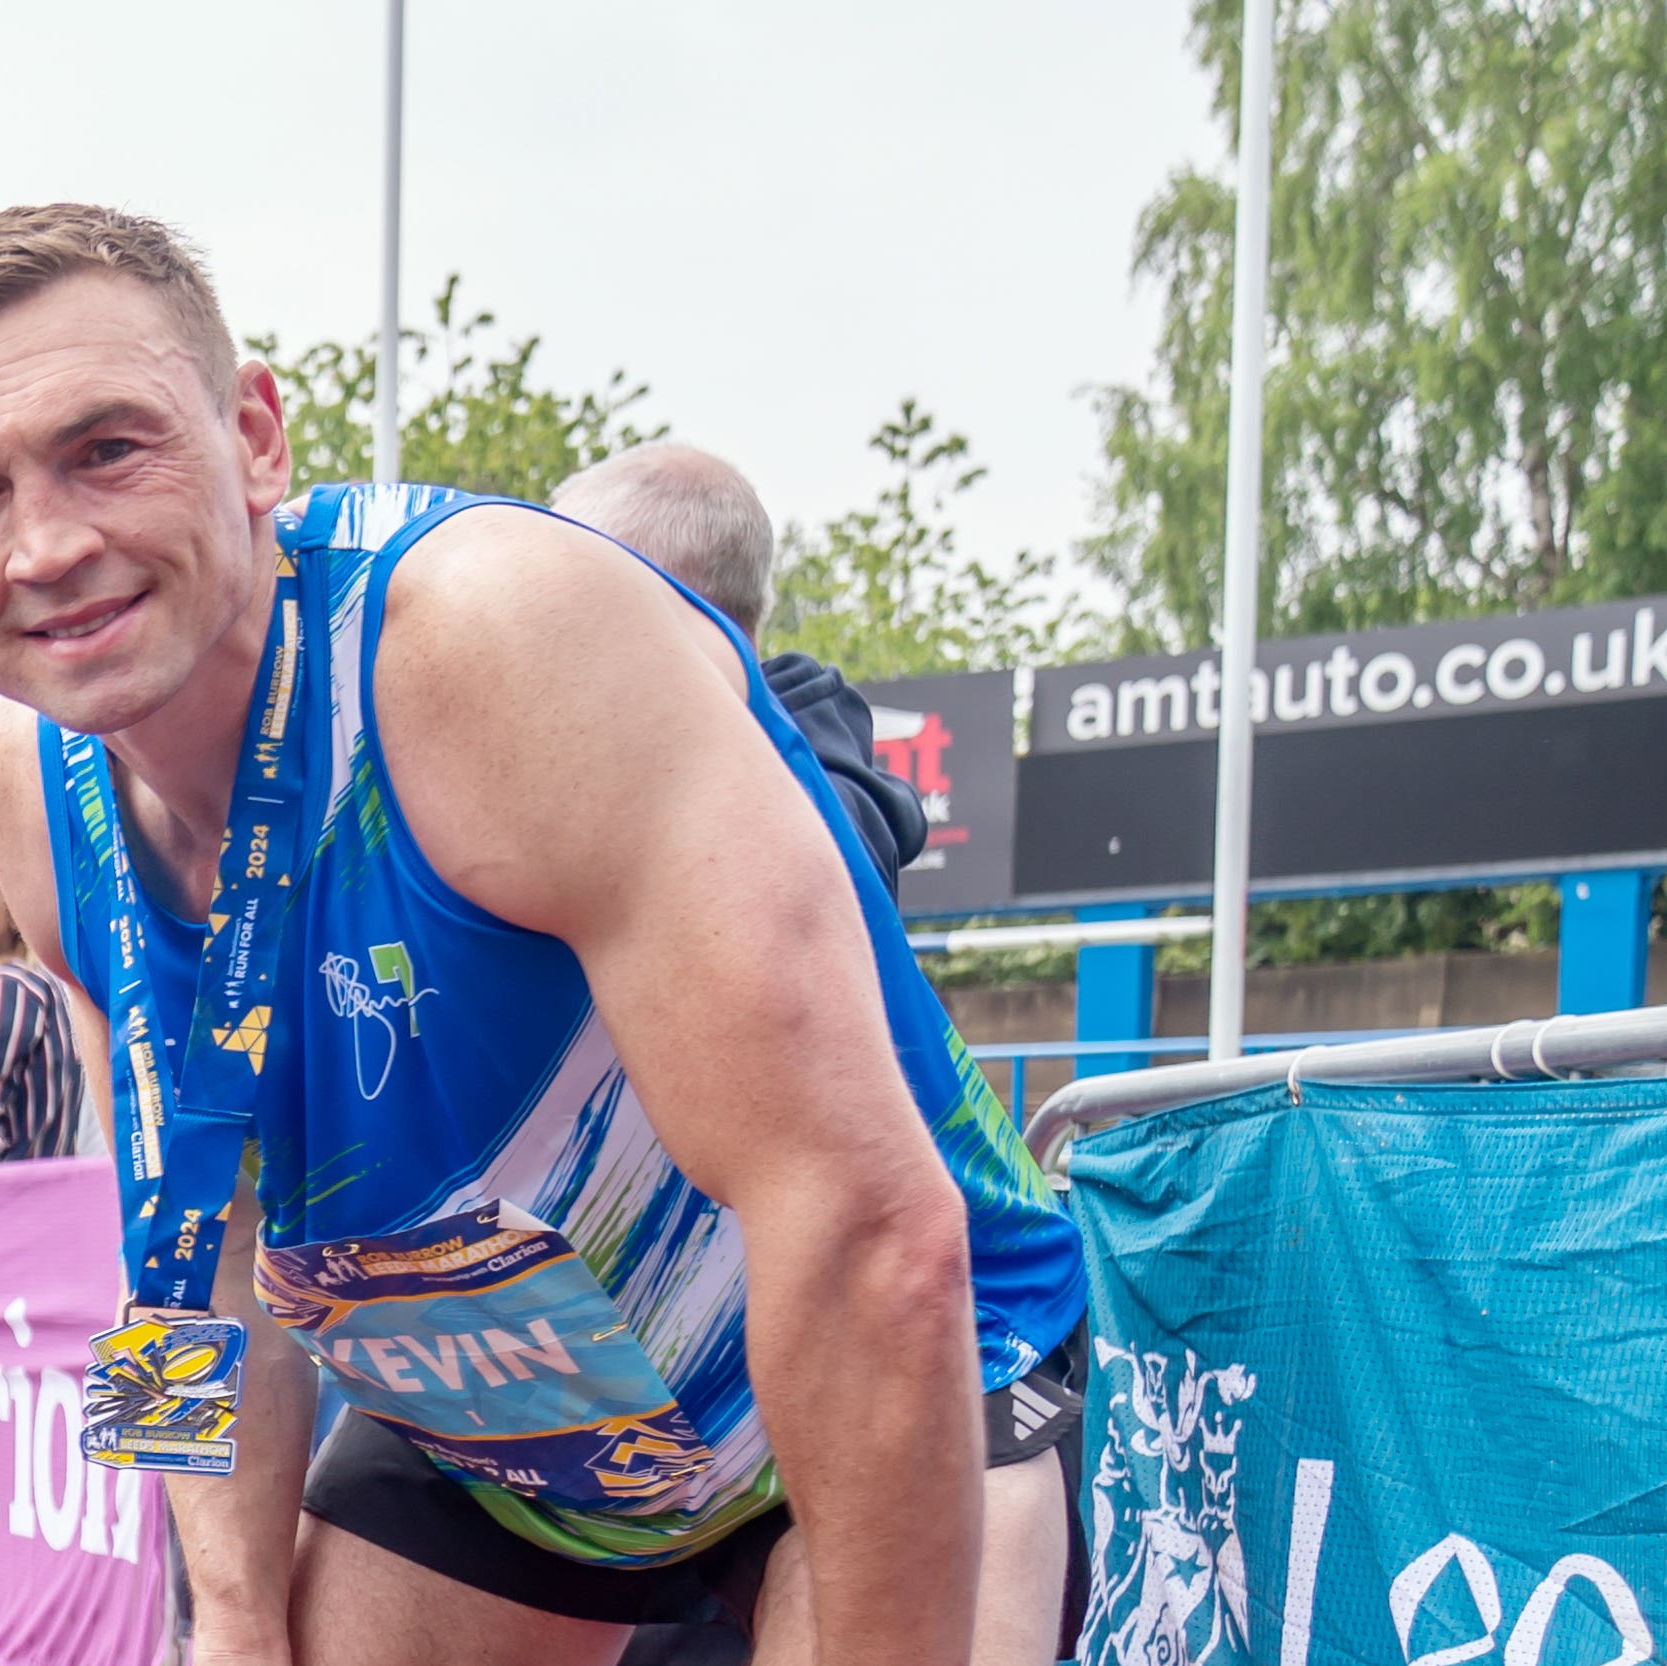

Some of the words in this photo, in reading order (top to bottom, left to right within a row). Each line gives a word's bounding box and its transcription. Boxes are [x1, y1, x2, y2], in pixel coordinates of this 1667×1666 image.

[246, 824, 270, 879] 2024
[245, 898, 259, 920] ALL
[240, 921, 255, 948] FOR
[234, 949, 250, 978] RUN
[131, 1131, 145, 1181] Clarion
[174, 1209, 203, 1261] 2024
[357, 1252, 393, 1265] ROB
[487, 1240, 548, 1272] Clarion
[367, 1260, 417, 1277] LEEDS
[172, 1279, 187, 1300] ALL
[313, 1318, 580, 1393] KEVIN
[119, 1439, 154, 1450] LEEDS
[158, 1440, 229, 1456] MARATHON
[188, 1457, 229, 1468] Clarion
[506, 1468, 549, 1486] ALL
